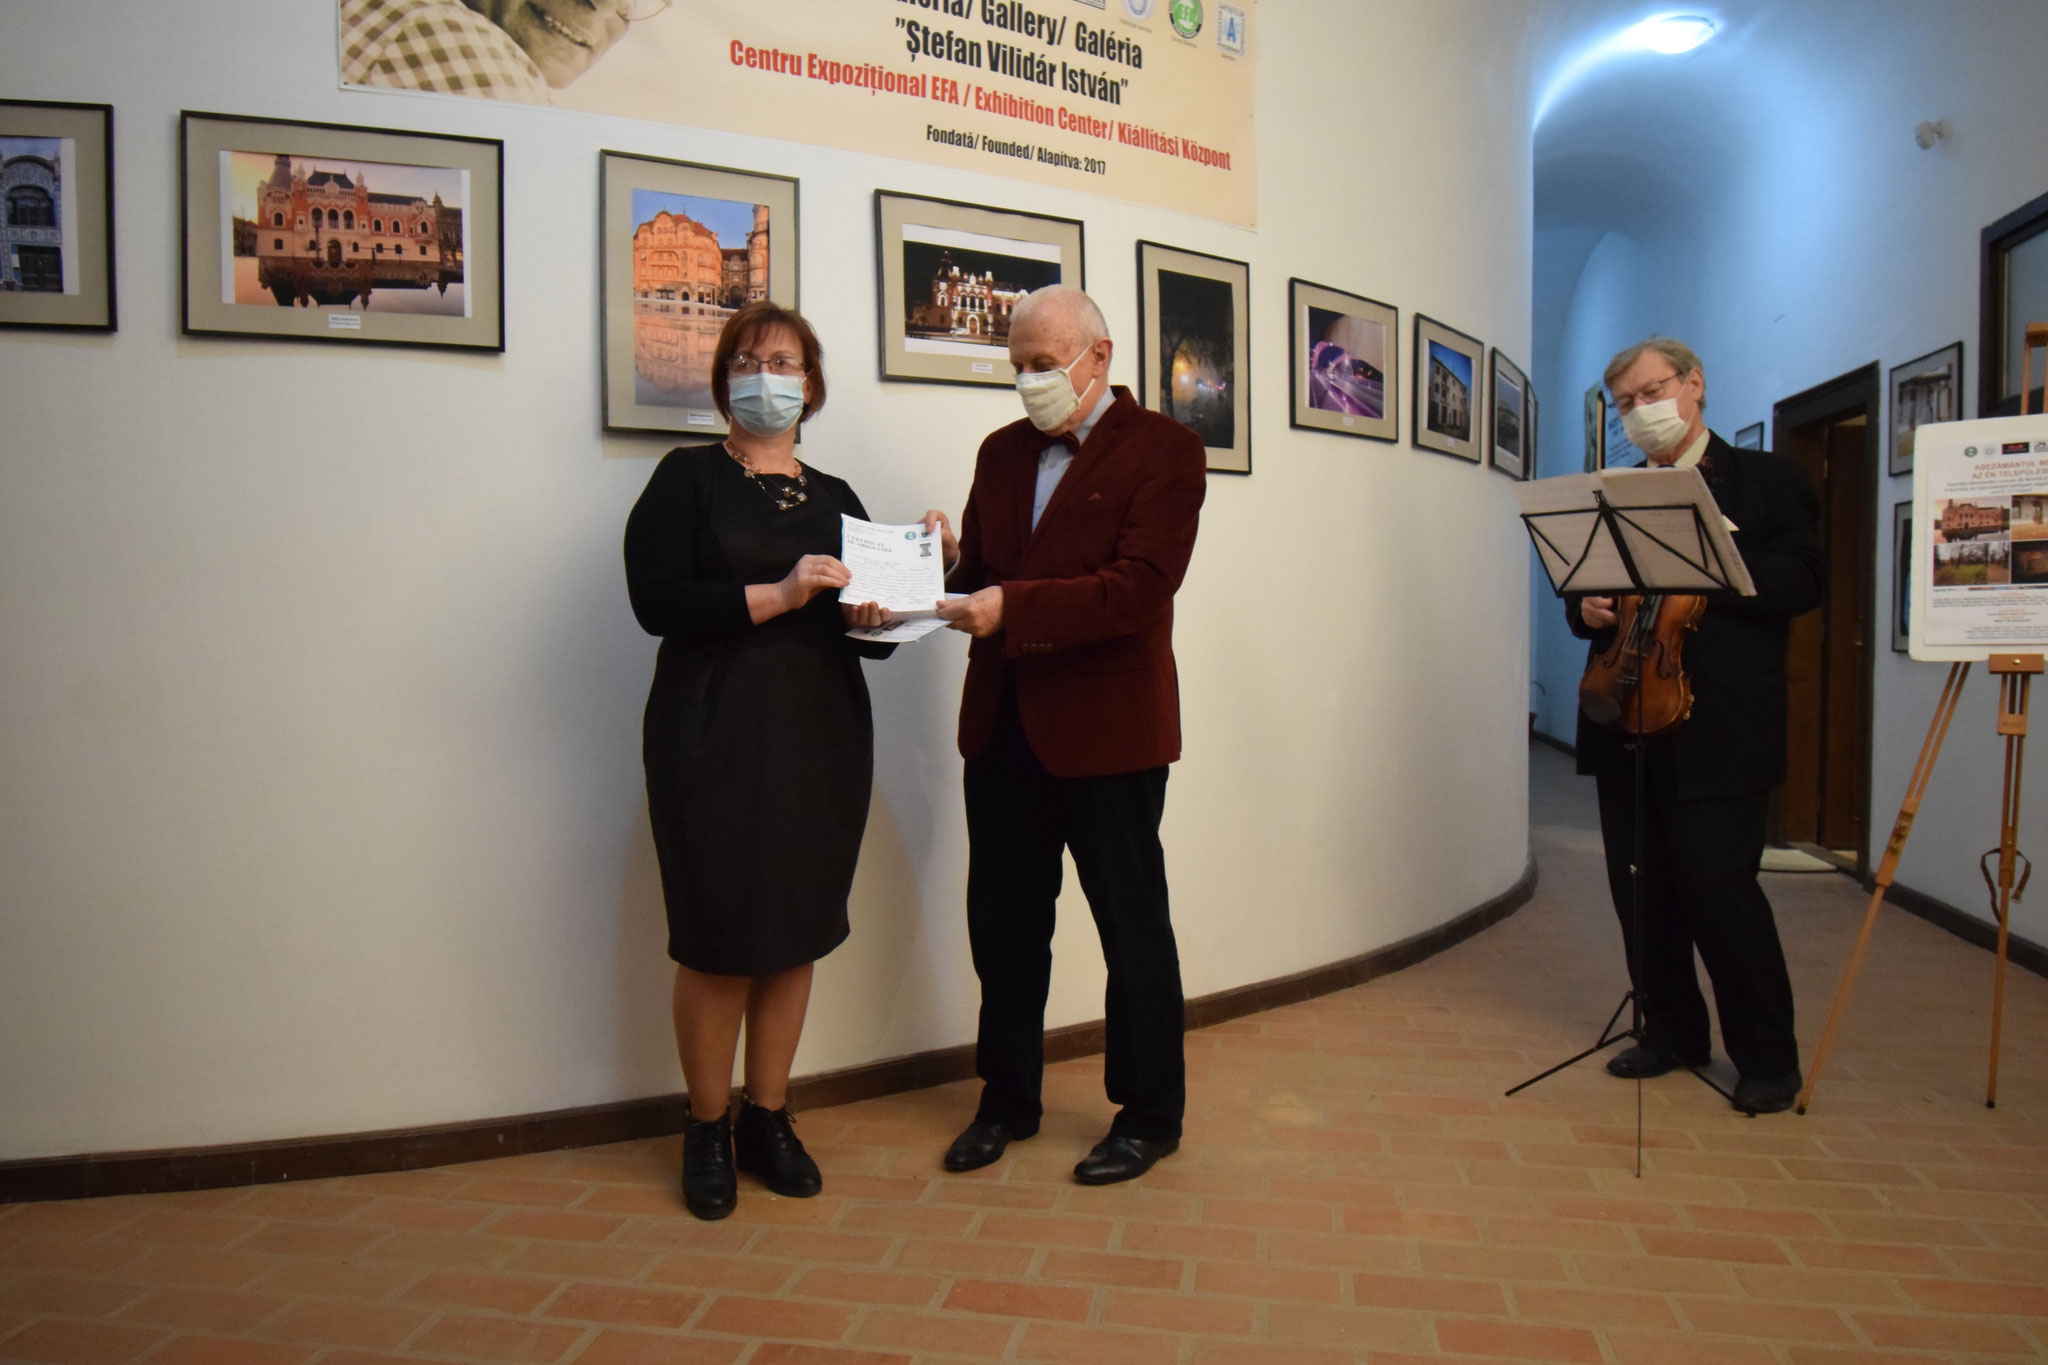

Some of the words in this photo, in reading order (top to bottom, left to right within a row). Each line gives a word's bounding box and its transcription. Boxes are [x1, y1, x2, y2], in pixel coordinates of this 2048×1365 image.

[981, 0, 1067, 46] Gallery/
[1075, 20, 1143, 69] Galéria
[987, 40, 1057, 87] Vilidár
[729, 39, 802, 77] Centru
[807, 52, 927, 98] Expozițional
[931, 75, 959, 105] EFA
[975, 86, 1054, 127] Exhibition
[1058, 106, 1114, 141] Center/
[1117, 121, 1180, 157] Kiállítási
[1181, 138, 1232, 171] Központ
[982, 135, 1035, 161] Founded/
[1037, 146, 1082, 171] Alapítva:
[1084, 156, 1106, 176] 2017
